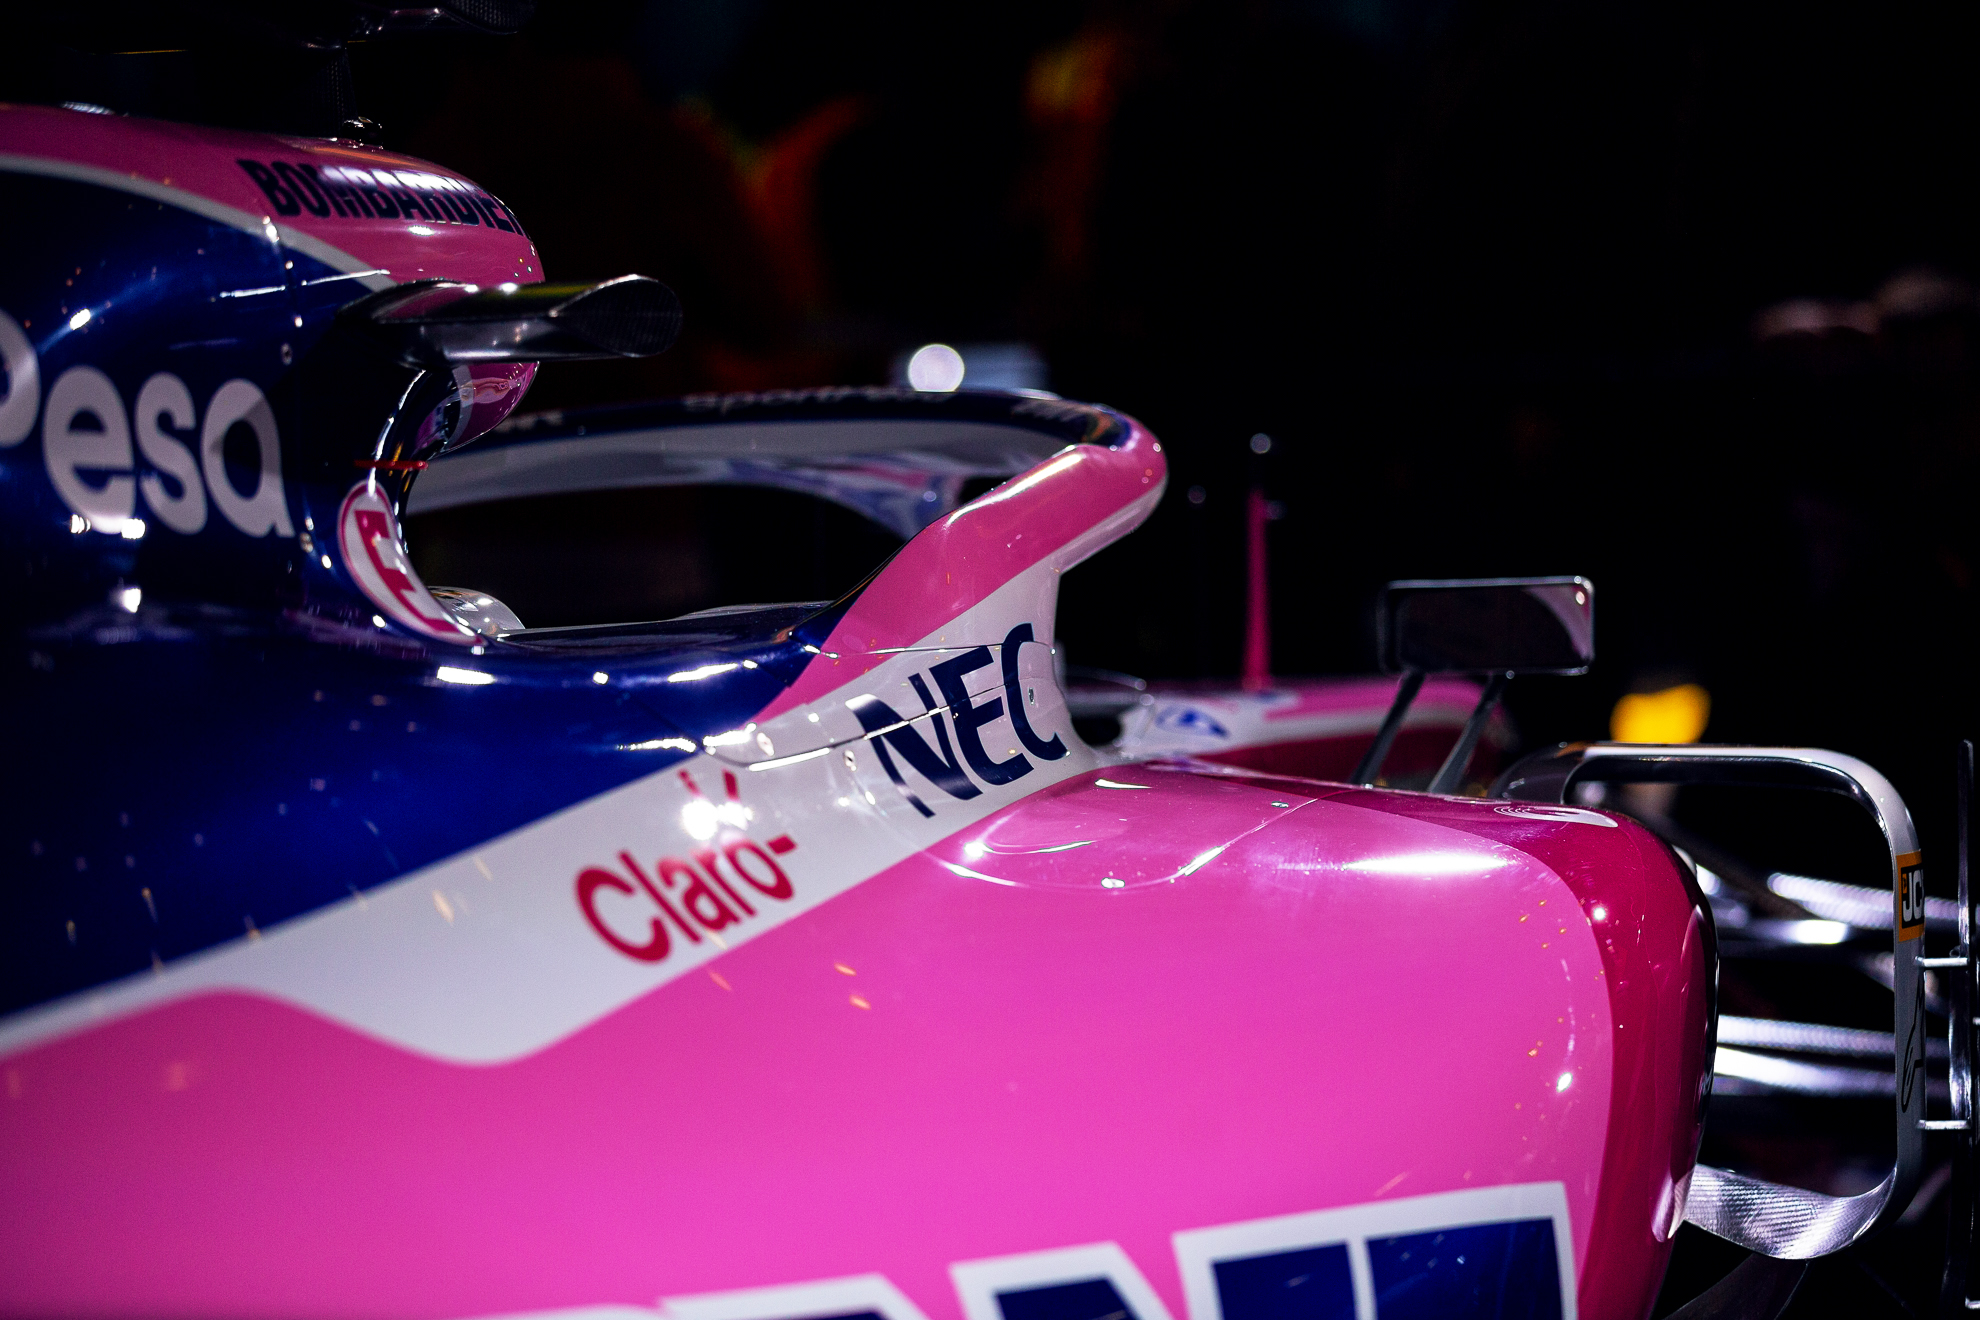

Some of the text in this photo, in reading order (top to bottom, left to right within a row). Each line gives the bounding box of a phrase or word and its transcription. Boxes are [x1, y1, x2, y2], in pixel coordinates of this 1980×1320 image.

[237, 158, 526, 237] BOMBARDIE
[845, 623, 1069, 818] NEC
[577, 842, 793, 961] Claro
[1902, 868, 1924, 923] JC
